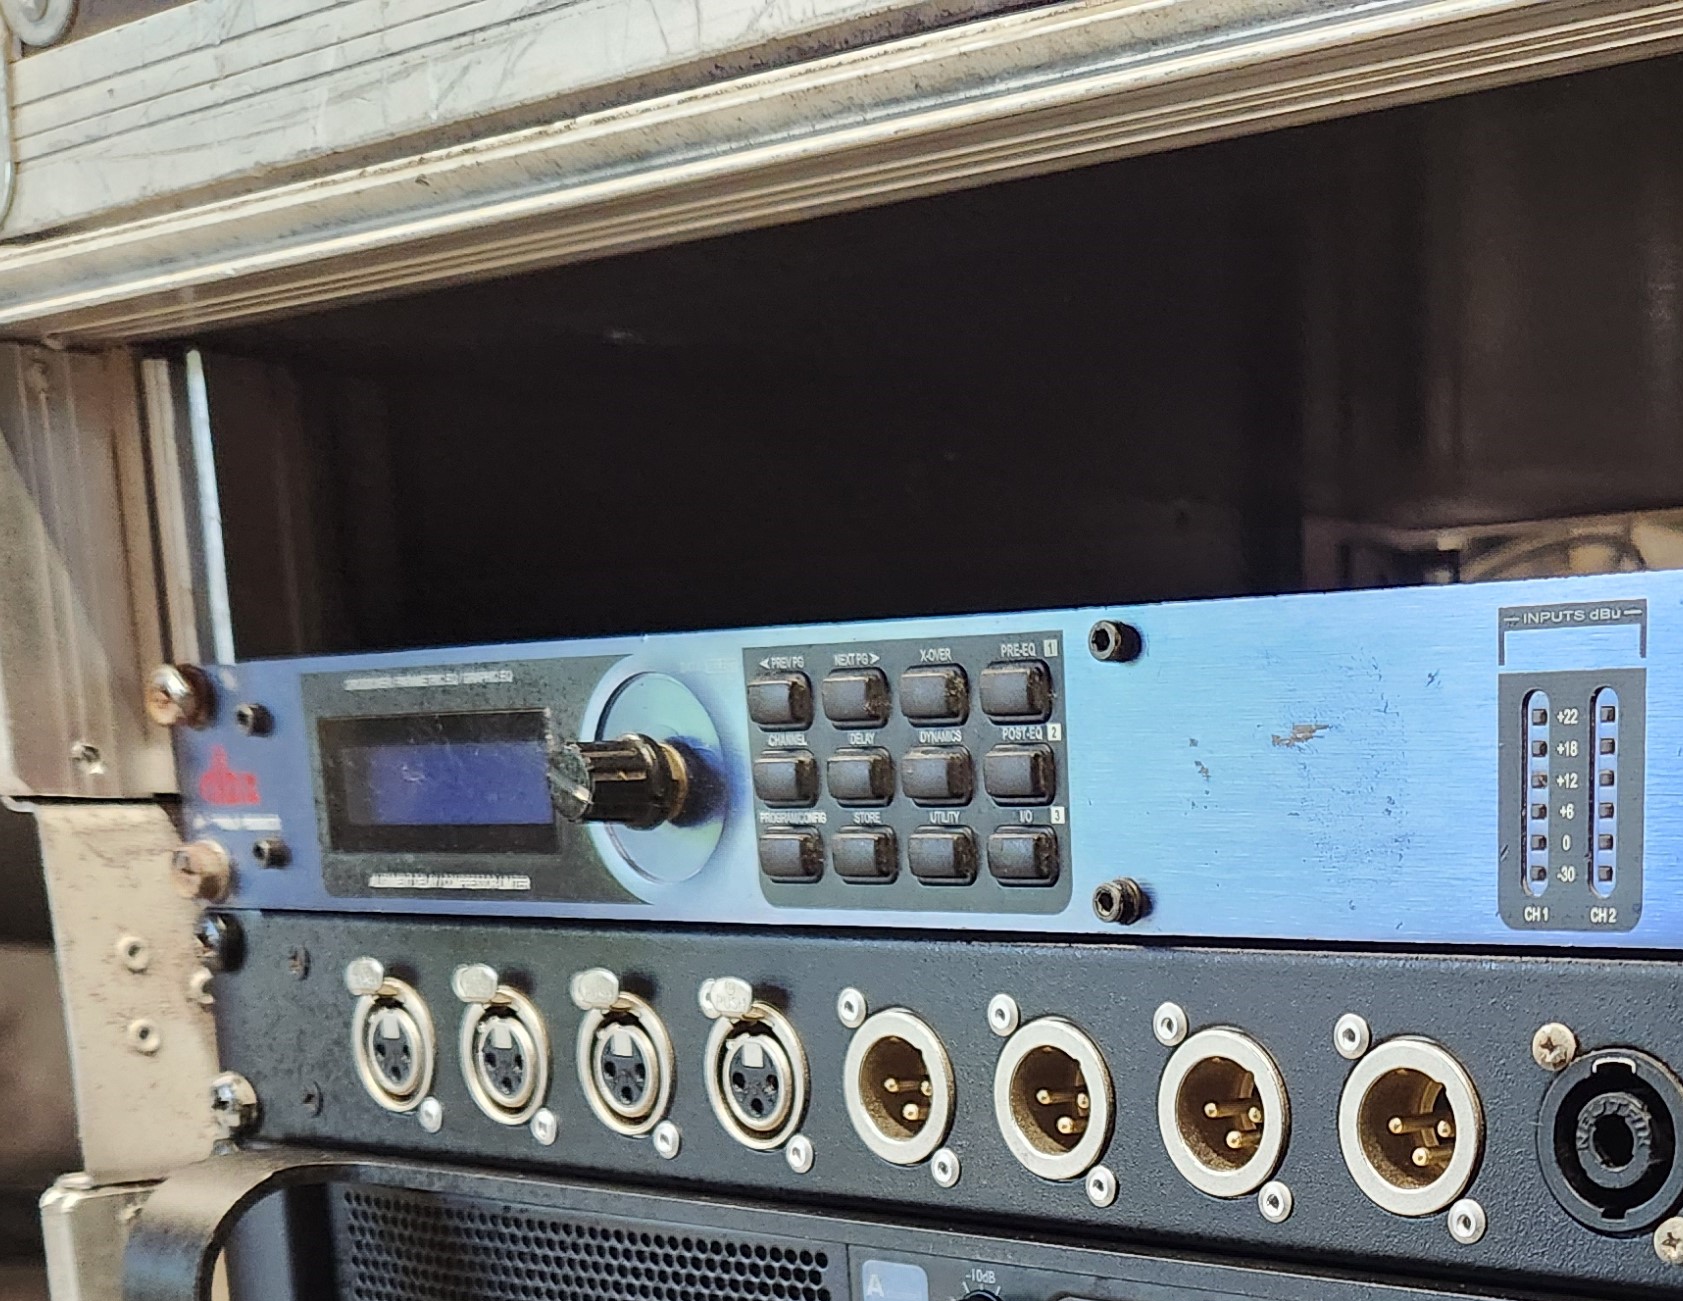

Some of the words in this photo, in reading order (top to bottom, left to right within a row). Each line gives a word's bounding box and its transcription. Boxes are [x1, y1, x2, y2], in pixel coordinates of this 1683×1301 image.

[1523, 610, 1585, 624] INPUTS
[1590, 607, 1621, 621] dBu
[920, 648, 952, 662] X-OVER
[1001, 643, 1036, 657] PRE-EQ
[771, 656, 791, 669] PREV
[792, 655, 804, 668] PG
[835, 653, 853, 666] NEXT
[854, 652, 868, 665] PG
[1557, 709, 1578, 725] +22
[768, 733, 807, 746] CHANNEL
[850, 732, 876, 745] DELAY
[920, 729, 962, 743] DYNAMICS
[1002, 727, 1043, 741] POST-EQ
[1557, 740, 1578, 757] +18
[1557, 772, 1578, 788] +12
[853, 811, 881, 824] STORE
[930, 811, 961, 824] UTILITY
[1019, 809, 1033, 824] I/O
[1559, 804, 1574, 819] +6
[1562, 835, 1570, 851] 0
[1557, 866, 1576, 882] -30
[965, 1268, 996, 1284] -10dB
[867, 1274, 885, 1297] A
